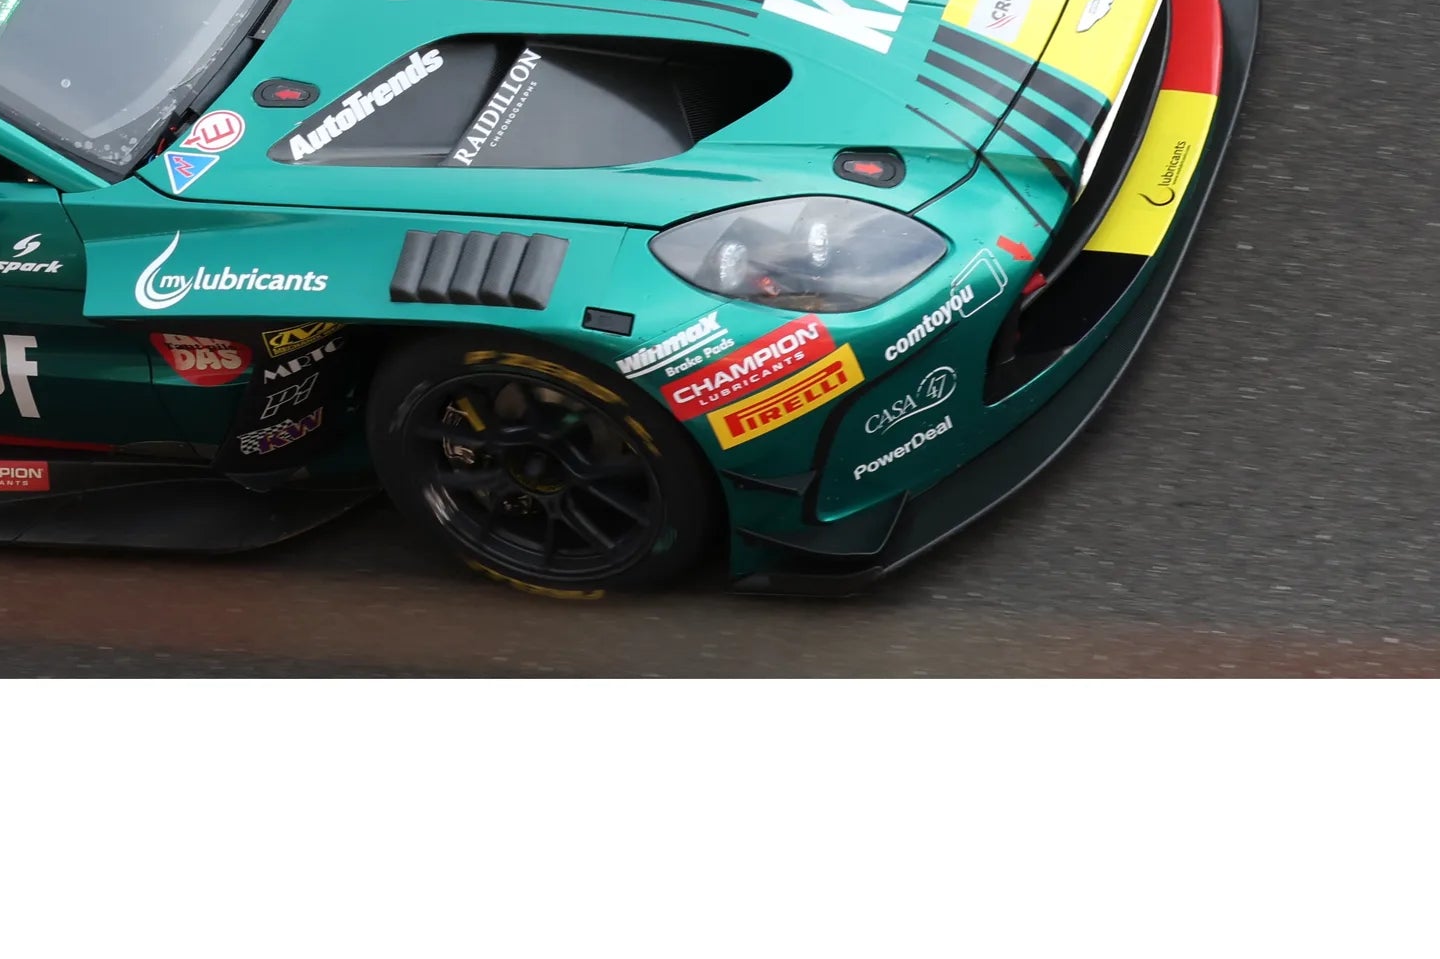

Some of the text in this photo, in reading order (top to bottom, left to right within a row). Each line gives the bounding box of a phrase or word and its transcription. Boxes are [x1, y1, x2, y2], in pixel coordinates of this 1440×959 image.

[288, 47, 444, 161] AutoTrends
[453, 47, 542, 167] RAIDILLON
[489, 80, 538, 148] CHRONOGRAPHS
[884, 283, 975, 362] comtoyou
[172, 348, 242, 371] DAS
[665, 337, 735, 378] Brake Pads
[672, 322, 820, 404] CHAMPION
[699, 351, 805, 406] LUBRICANTS
[723, 359, 848, 438] PIRELLI
[864, 375, 947, 435] CASA 47
[854, 416, 953, 480] PowerDeal
